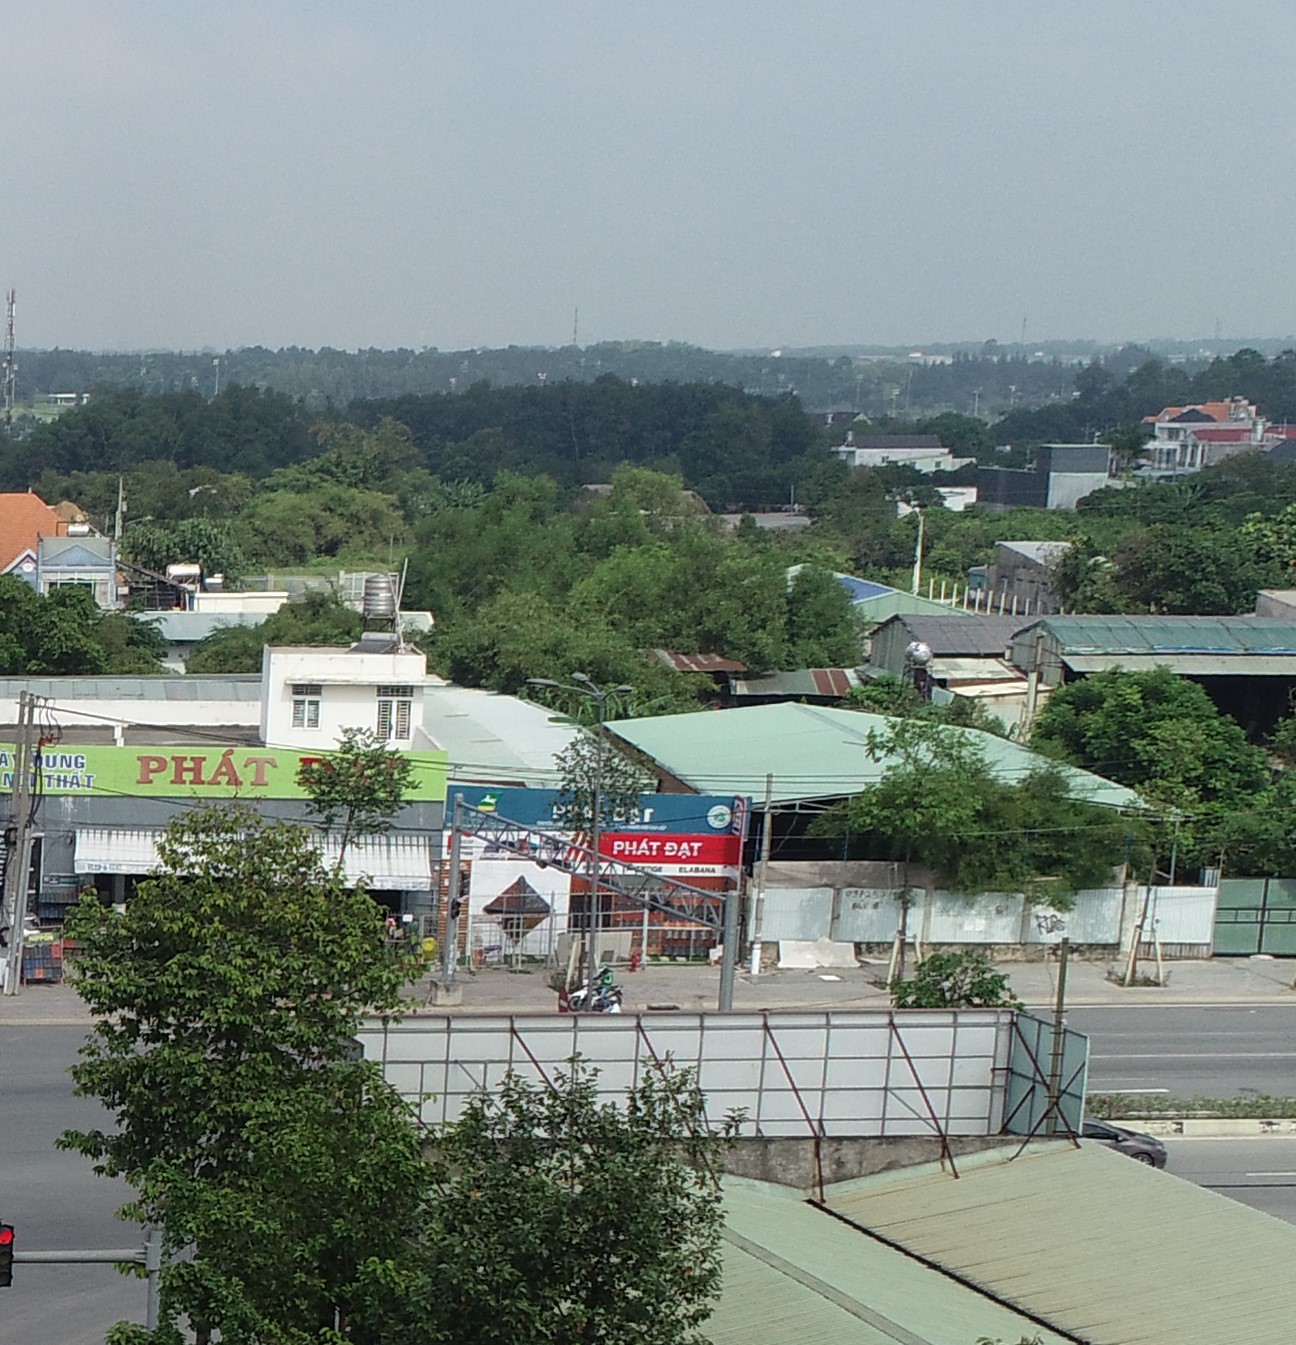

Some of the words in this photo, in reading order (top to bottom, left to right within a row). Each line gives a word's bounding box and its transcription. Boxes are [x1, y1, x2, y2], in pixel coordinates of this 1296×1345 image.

[135, 748, 278, 787] PHÁT
[612, 838, 661, 856] PHÁT
[663, 842, 703, 860] ĐẠT
